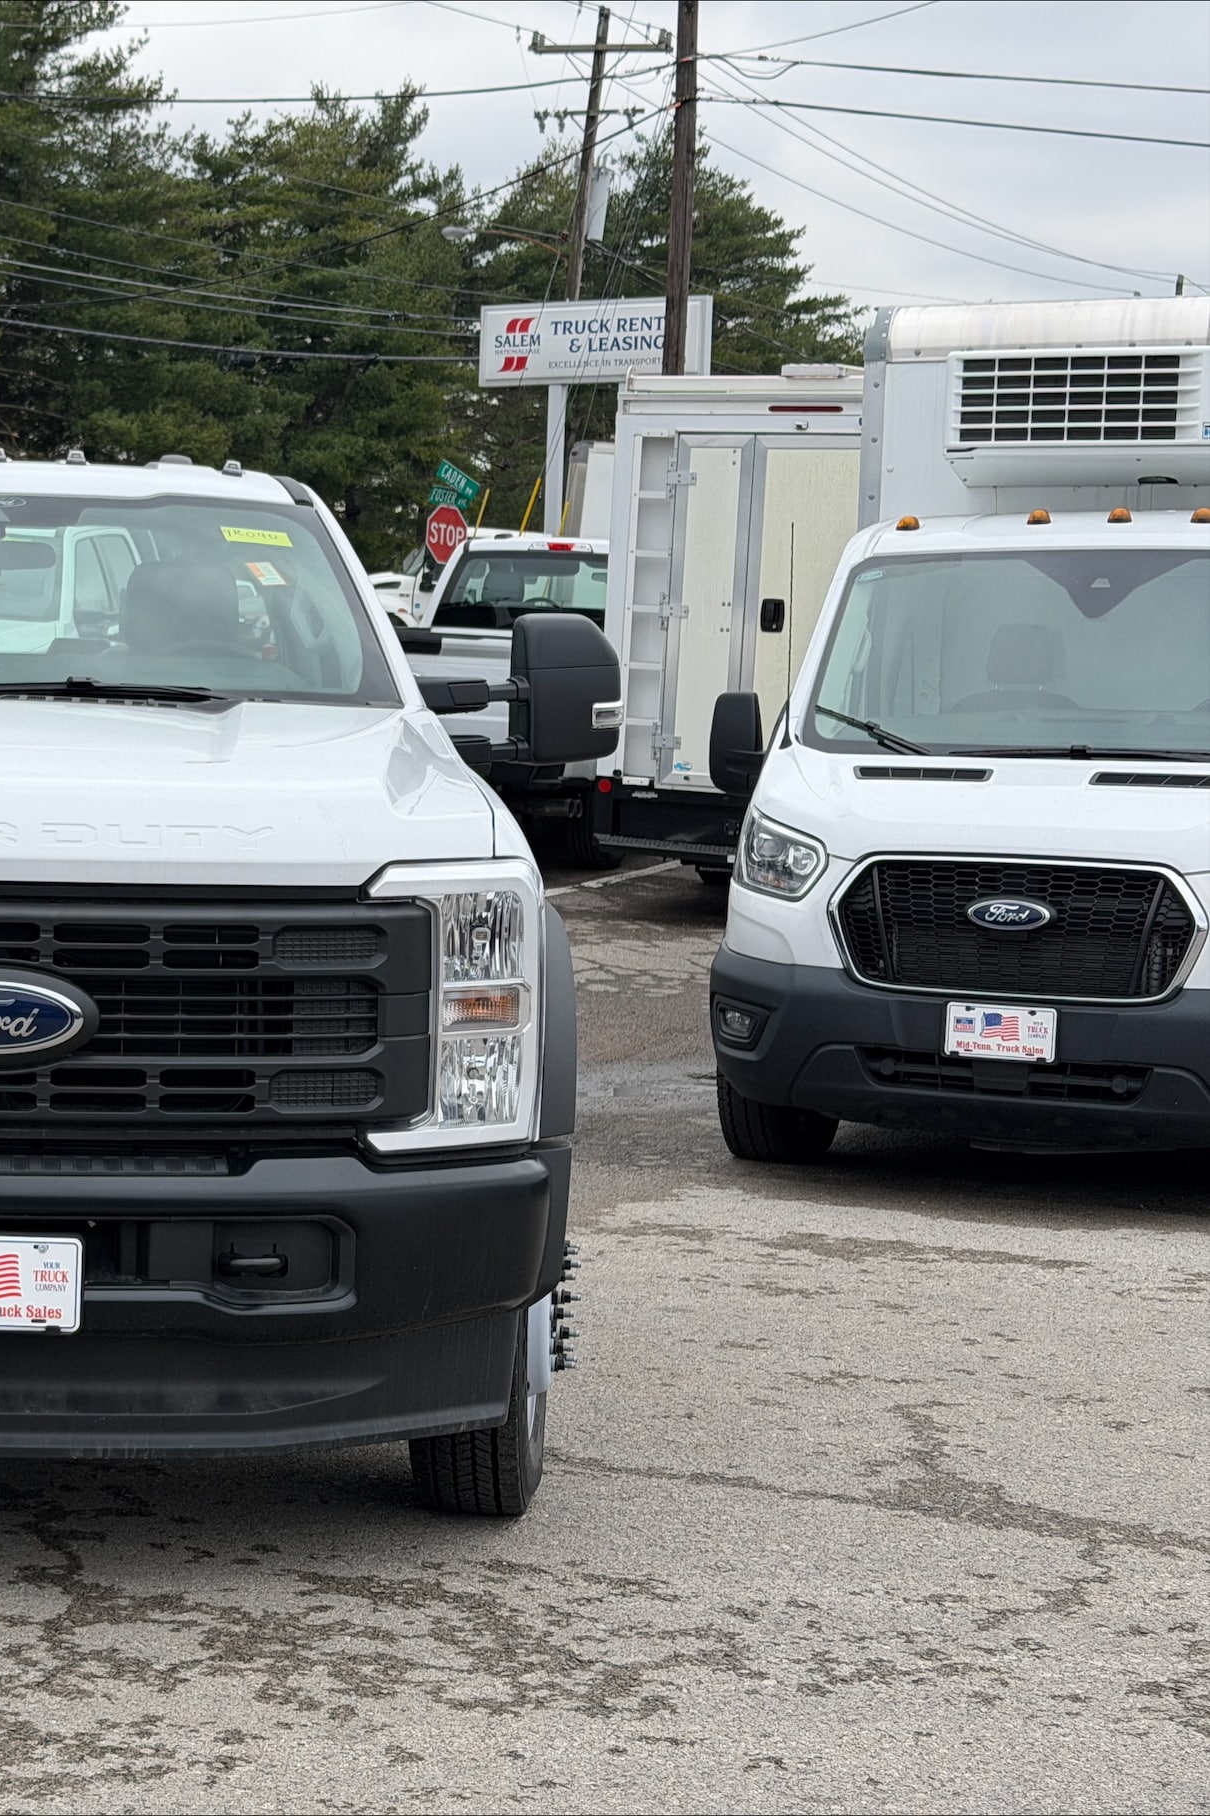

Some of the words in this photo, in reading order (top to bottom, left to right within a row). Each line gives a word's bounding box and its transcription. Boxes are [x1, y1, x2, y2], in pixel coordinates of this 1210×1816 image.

[550, 318, 611, 336] TRUCK
[494, 334, 541, 349] SALEM
[568, 338, 582, 353] &
[440, 464, 468, 491] CADEN
[430, 487, 458, 505] FOSTER
[429, 521, 465, 547] STOP
[40, 821, 276, 850] DUTY
[984, 903, 1031, 923] Ford
[996, 1043, 1021, 1054] Truck
[42, 1261, 61, 1269] YOUR
[32, 1270, 70, 1283] TRUCK
[34, 1283, 68, 1293] COMPANY
[25, 1304, 62, 1320] Sales
